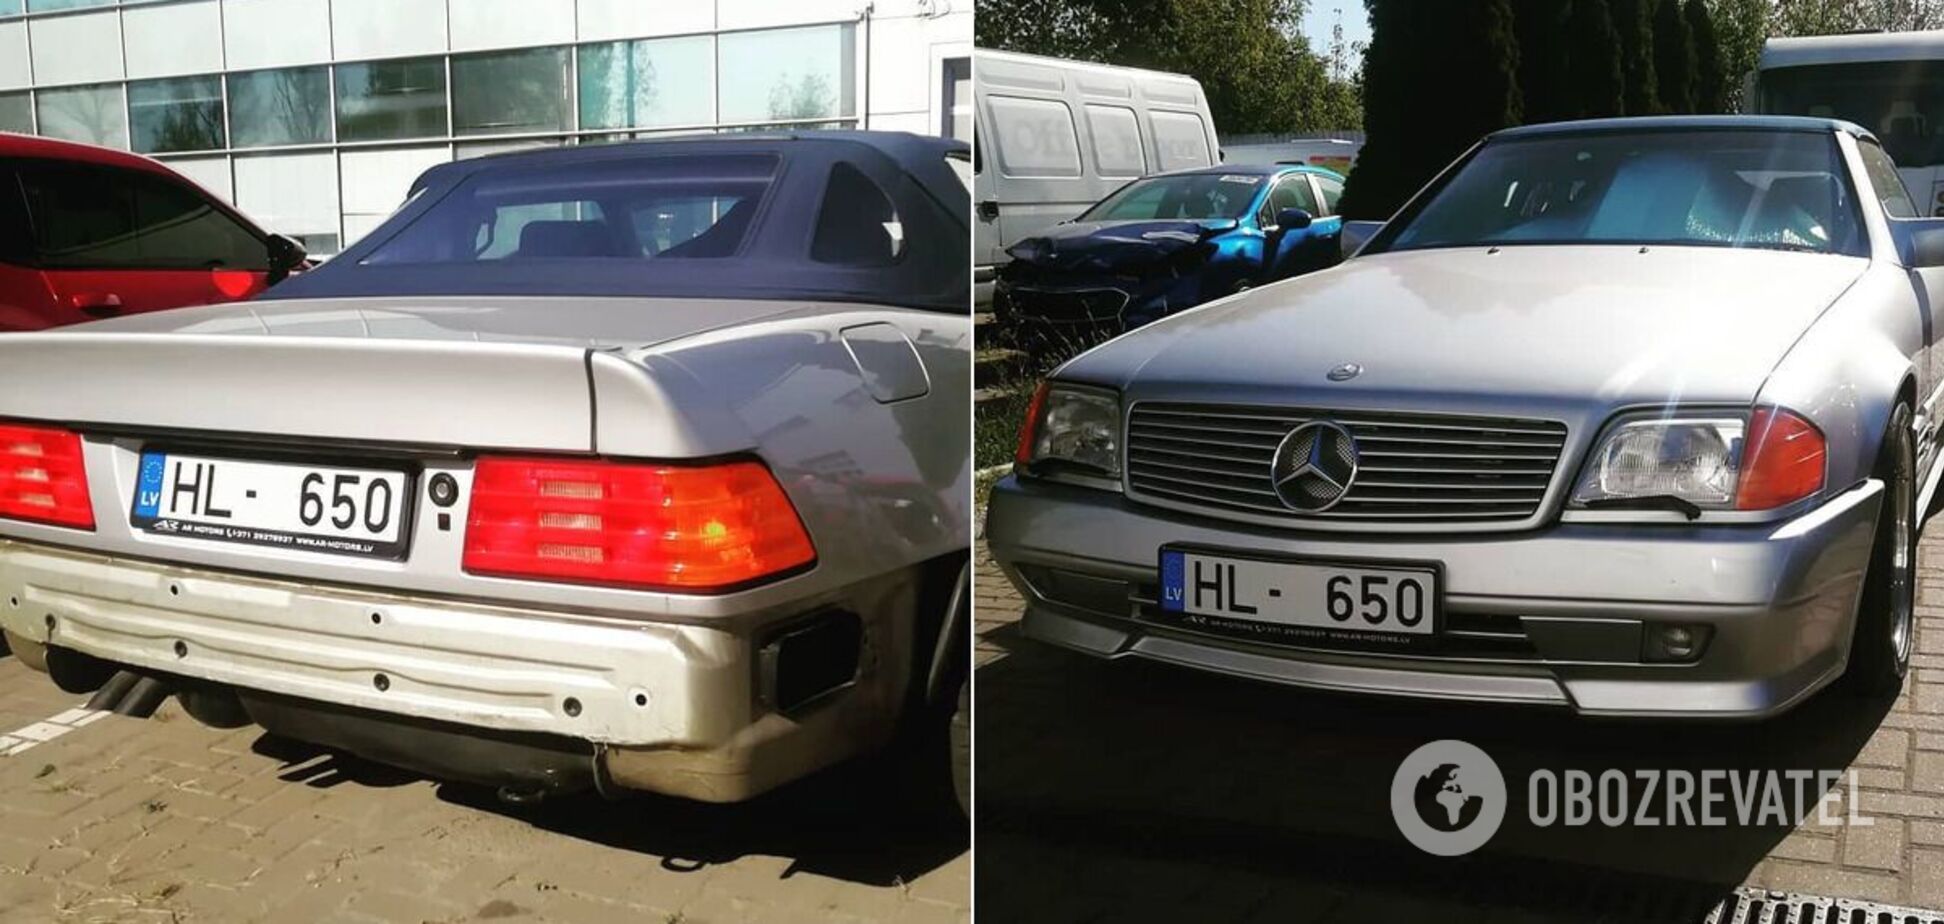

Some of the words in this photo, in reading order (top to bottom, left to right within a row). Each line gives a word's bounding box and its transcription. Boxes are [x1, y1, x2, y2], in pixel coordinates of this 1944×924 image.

[140, 491, 160, 507] LV
[299, 472, 392, 534] 650
[1165, 587, 1182, 602] LV
[1326, 575, 1424, 628] 650
